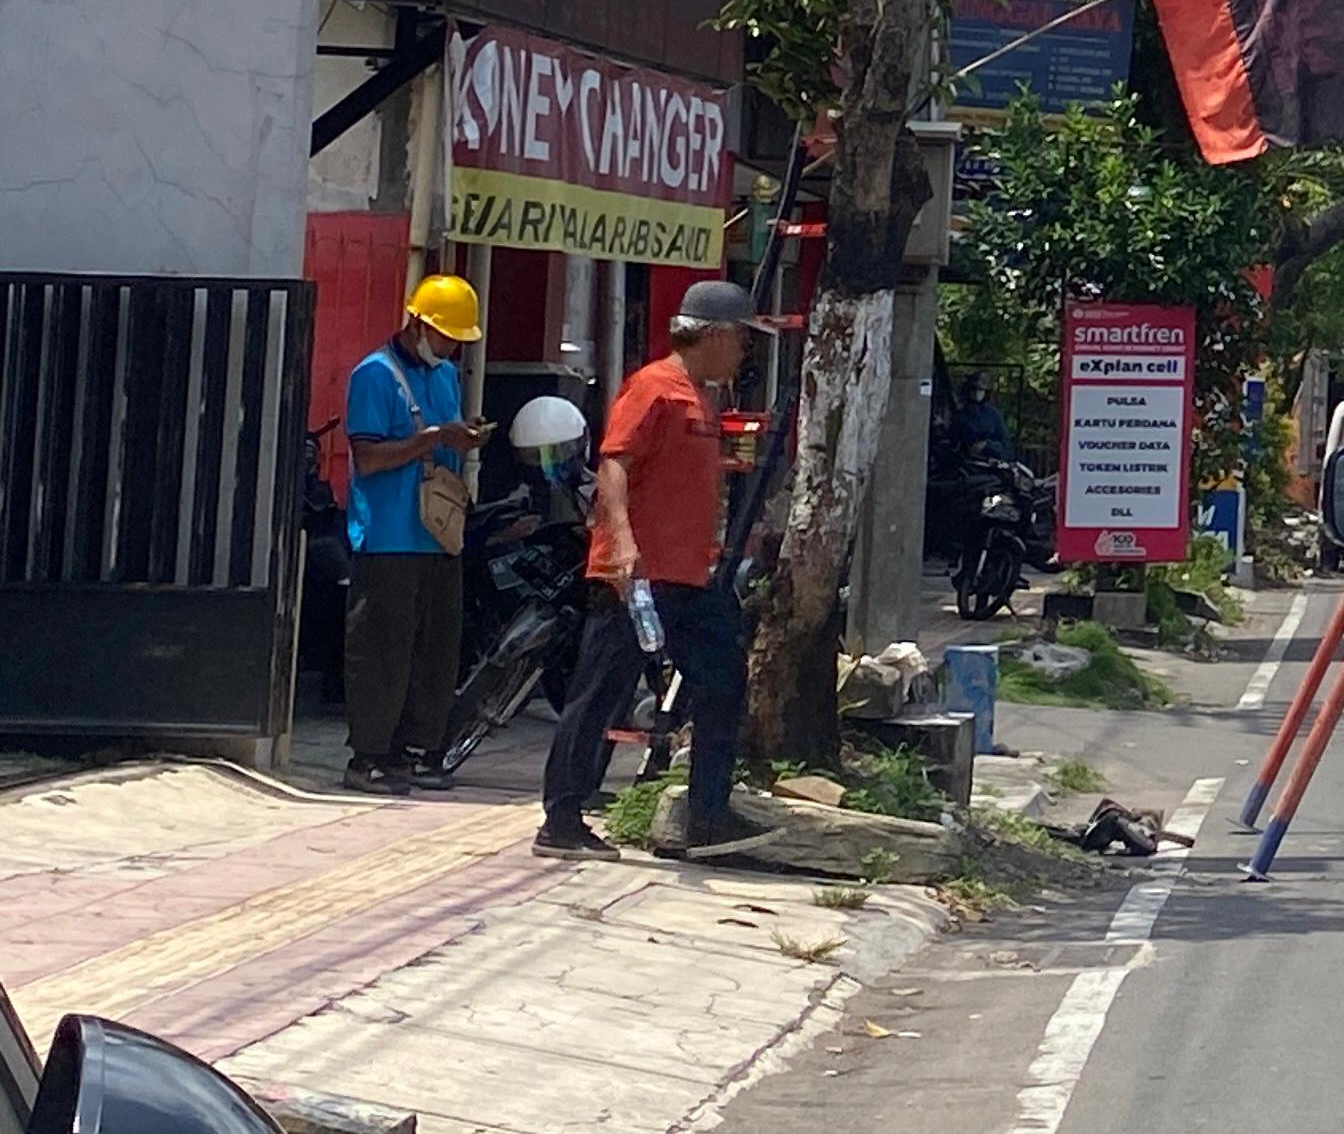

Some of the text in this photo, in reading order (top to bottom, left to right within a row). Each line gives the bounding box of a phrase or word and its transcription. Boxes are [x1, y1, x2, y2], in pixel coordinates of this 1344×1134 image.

[579, 68, 724, 192] CHANGER
[1074, 322, 1185, 344] smartfren
[1147, 359, 1178, 373] cell
[1106, 397, 1147, 406] PULSA
[1074, 418, 1177, 428] KARTU PERDANA
[1078, 440, 1171, 450] VOUCHER DATA
[1079, 463, 1168, 473] TOKEN LISTRIK
[1110, 507, 1134, 517] DLL
